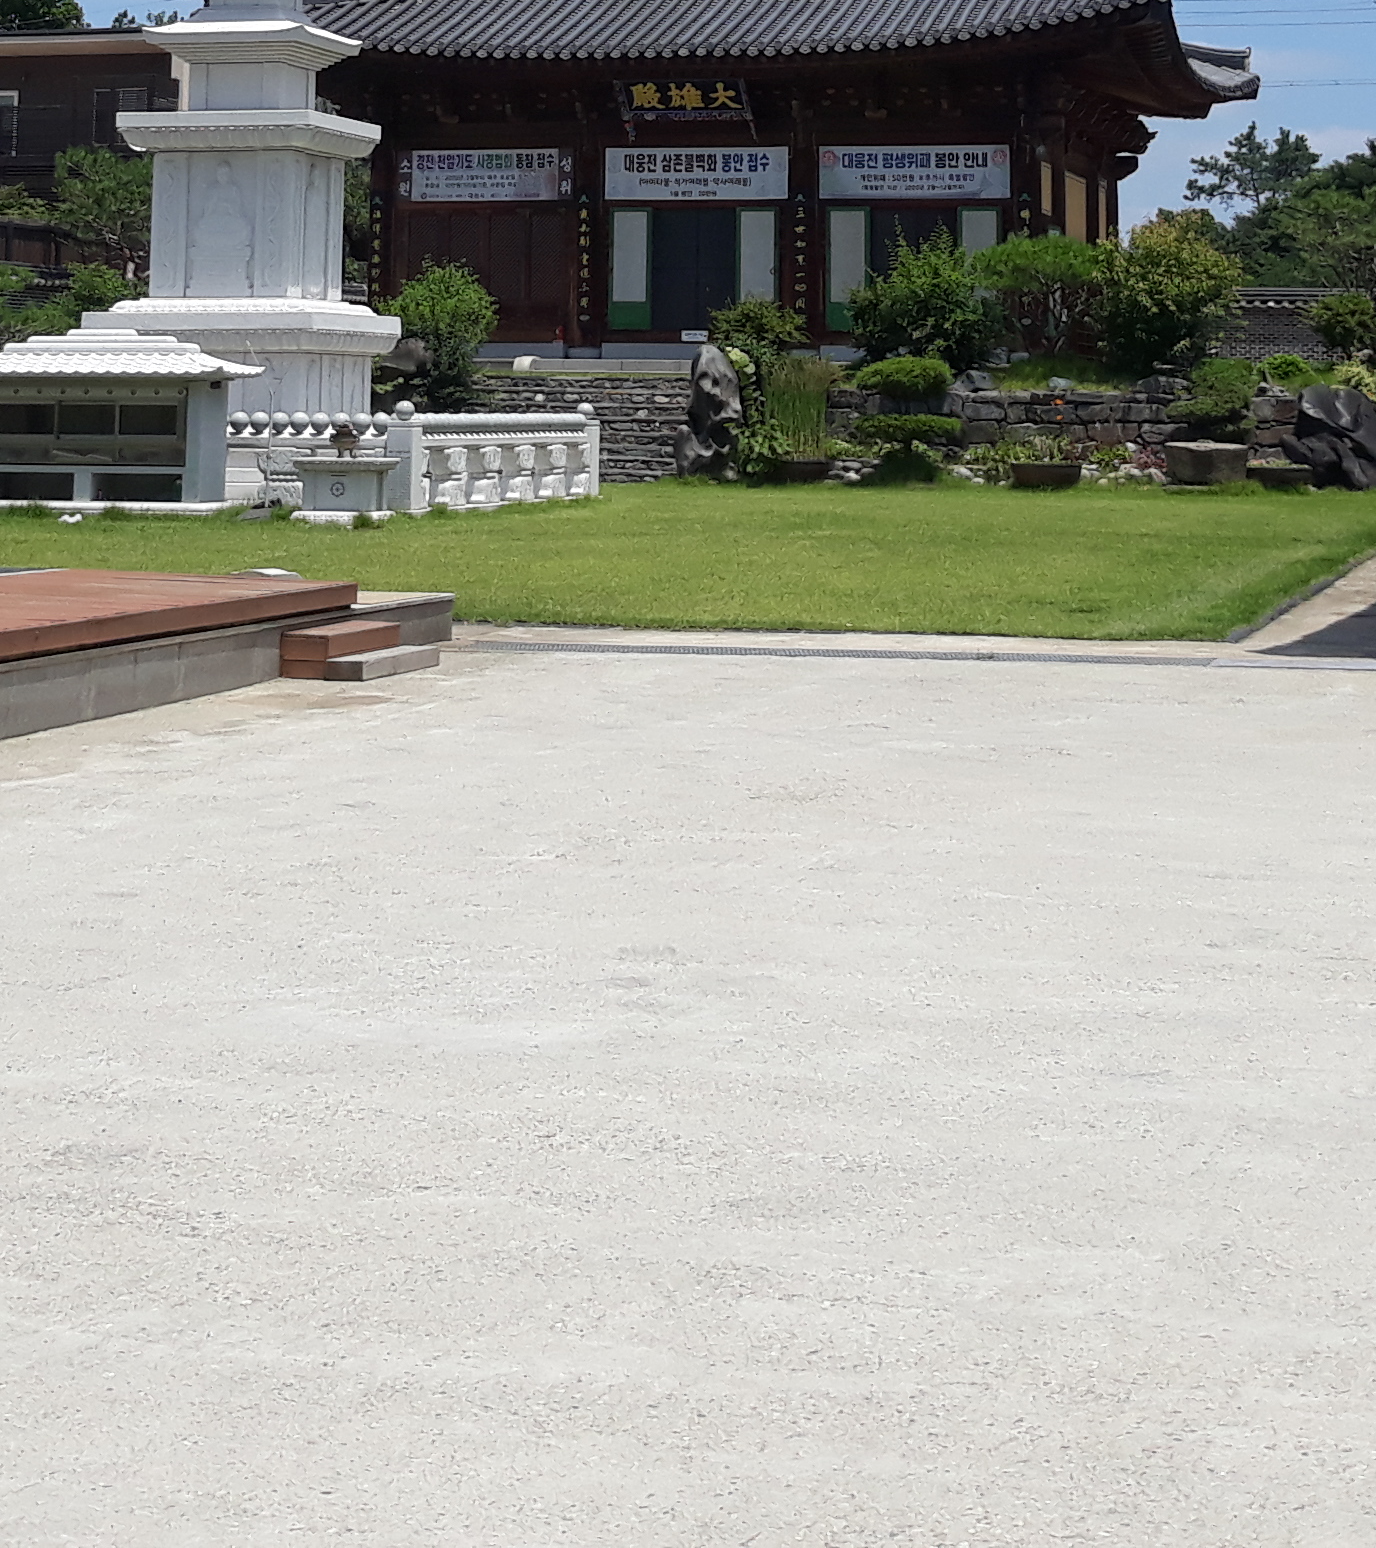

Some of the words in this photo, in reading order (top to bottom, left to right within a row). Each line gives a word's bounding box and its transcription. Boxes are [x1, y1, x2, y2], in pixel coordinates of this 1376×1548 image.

[536, 153, 555, 169] 접수
[624, 153, 657, 173] 대웅전
[721, 153, 744, 173] 봉안
[747, 153, 771, 173] 접수
[841, 152, 878, 169] 대웅전
[935, 152, 960, 169] 봉안
[963, 152, 988, 169] 안내
